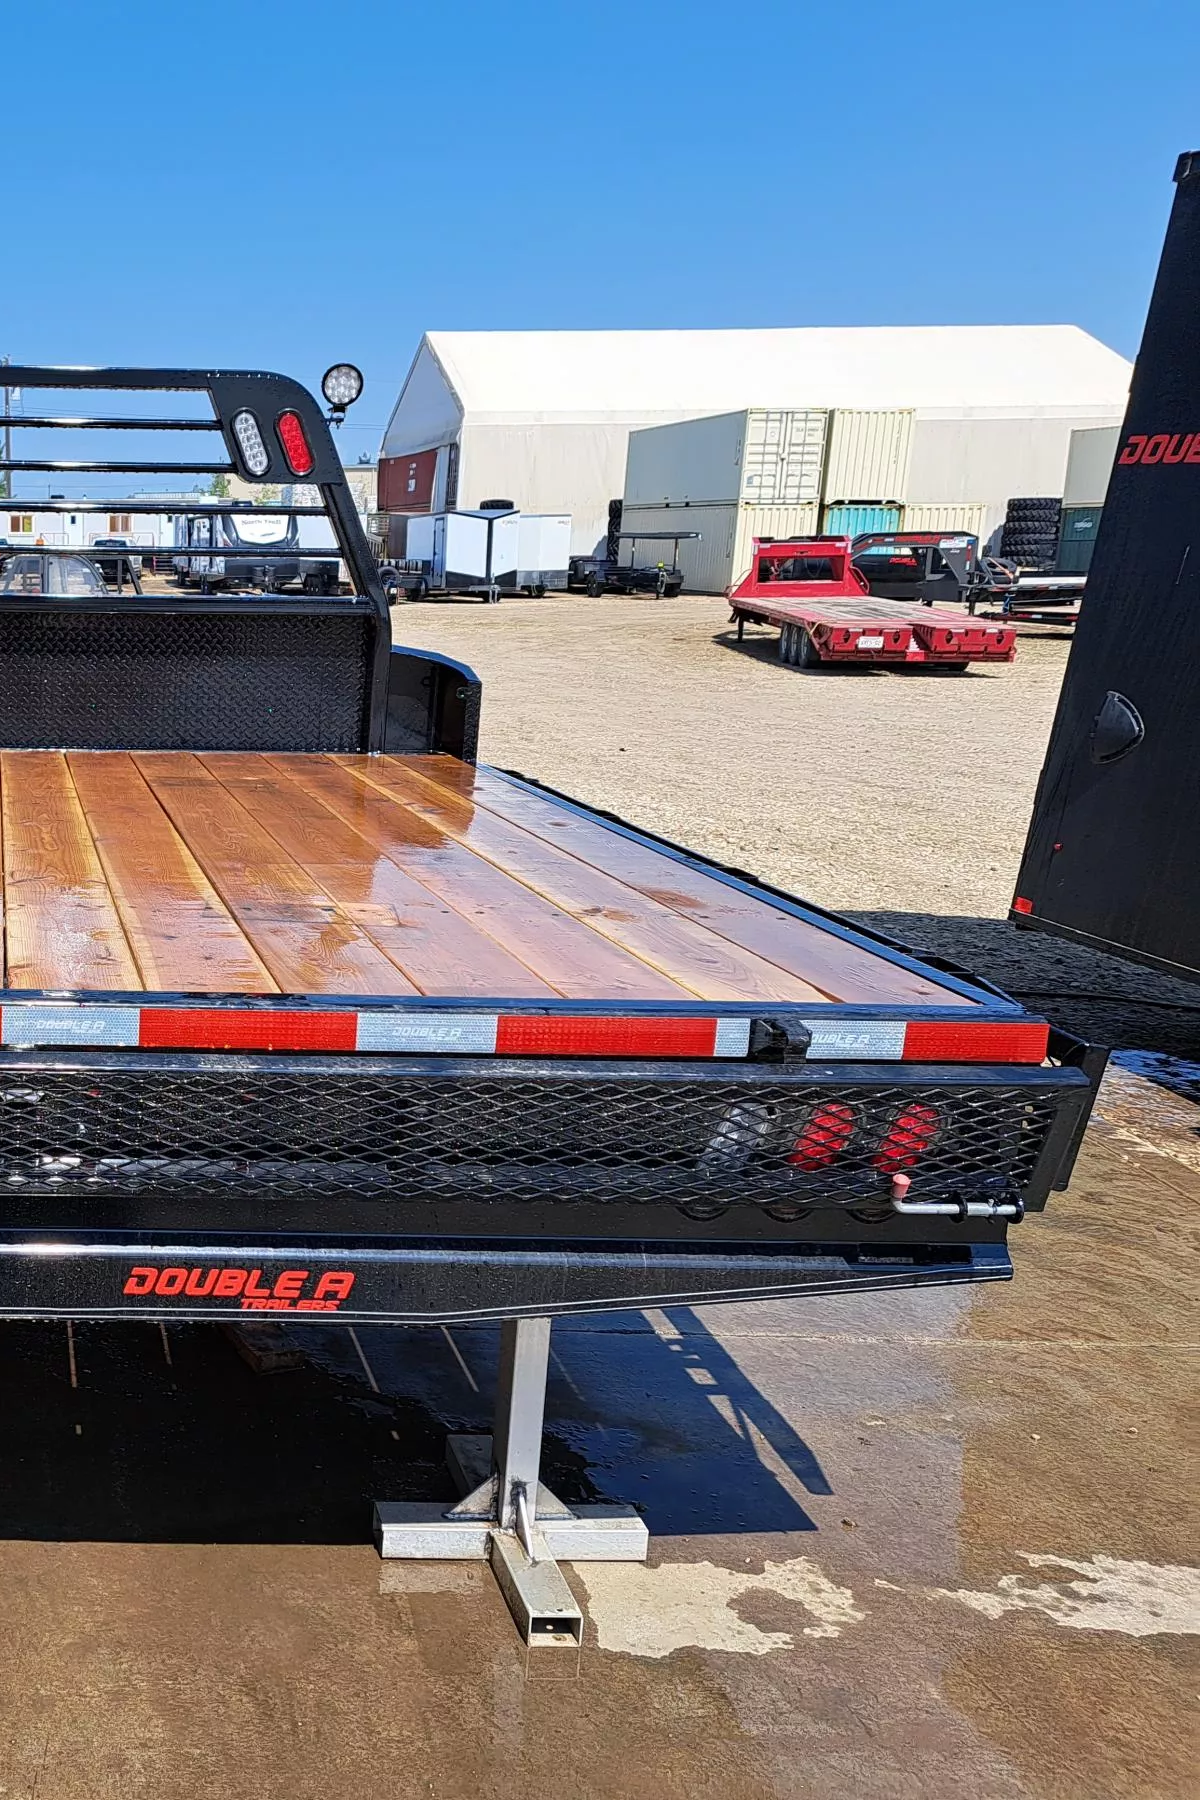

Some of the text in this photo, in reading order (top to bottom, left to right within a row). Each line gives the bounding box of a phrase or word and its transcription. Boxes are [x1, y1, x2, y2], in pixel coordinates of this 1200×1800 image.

[811, 1033, 857, 1043] OUBLE
[123, 1266, 356, 1299] DOUBLE A
[240, 1298, 340, 1311] TRAILERS
